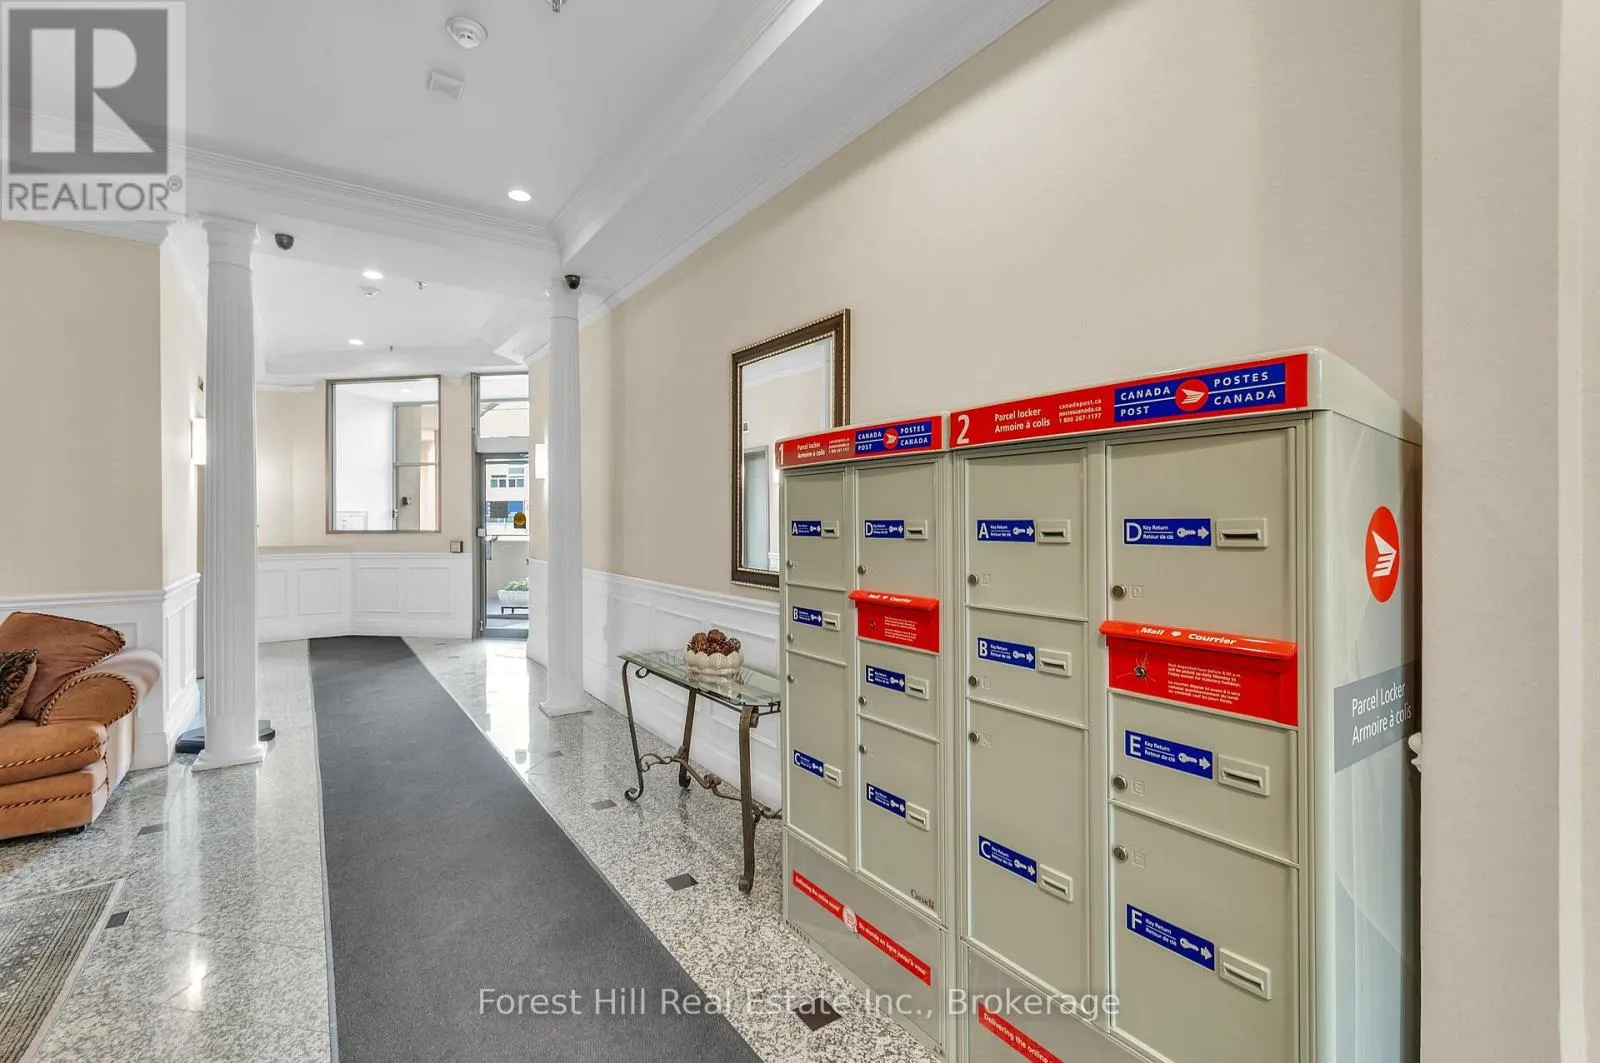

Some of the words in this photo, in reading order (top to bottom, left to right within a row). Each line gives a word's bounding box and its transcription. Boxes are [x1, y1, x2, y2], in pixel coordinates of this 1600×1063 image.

[1214, 371, 1269, 387] POSTES
[1120, 386, 1171, 401] CANADA
[1214, 389, 1277, 406] CANADA
[1059, 399, 1102, 410] canadapost.ca
[1120, 405, 1150, 417] POST
[994, 410, 1016, 422] Parcel
[1017, 408, 1042, 418] locker
[900, 425, 925, 434] POSTES
[956, 414, 970, 445] 2
[994, 421, 1024, 433] Armoire
[1026, 420, 1031, 429] à
[1032, 417, 1051, 428] colis
[858, 431, 882, 441] CANADA
[900, 436, 928, 446] CANADA
[778, 443, 785, 466] 1
[792, 522, 799, 535] A
[865, 522, 874, 536] D
[978, 522, 989, 539] A
[1126, 522, 1142, 542] D
[793, 608, 799, 620] B
[1140, 627, 1165, 636] Mail
[1188, 633, 1237, 645] Courrier
[979, 640, 988, 656] B
[867, 667, 874, 682] E
[1352, 688, 1379, 717] Parcel
[1380, 681, 1406, 706] Locker
[1351, 715, 1388, 746] Armoire
[1389, 709, 1395, 728] à
[1395, 702, 1412, 725] colis
[1130, 735, 1142, 757] E
[1144, 740, 1154, 748] Key
[1153, 743, 1171, 752] Return
[1144, 749, 1161, 758] Retour
[794, 752, 801, 766] C
[868, 785, 875, 800] F
[981, 841, 991, 859] C
[1131, 909, 1142, 929] F
[1145, 918, 1155, 927] Key
[1154, 922, 1172, 935] Return
[1145, 927, 1162, 939] Retour
[984, 1012, 1015, 1042] Delivering
[1015, 1036, 1026, 1049] the
